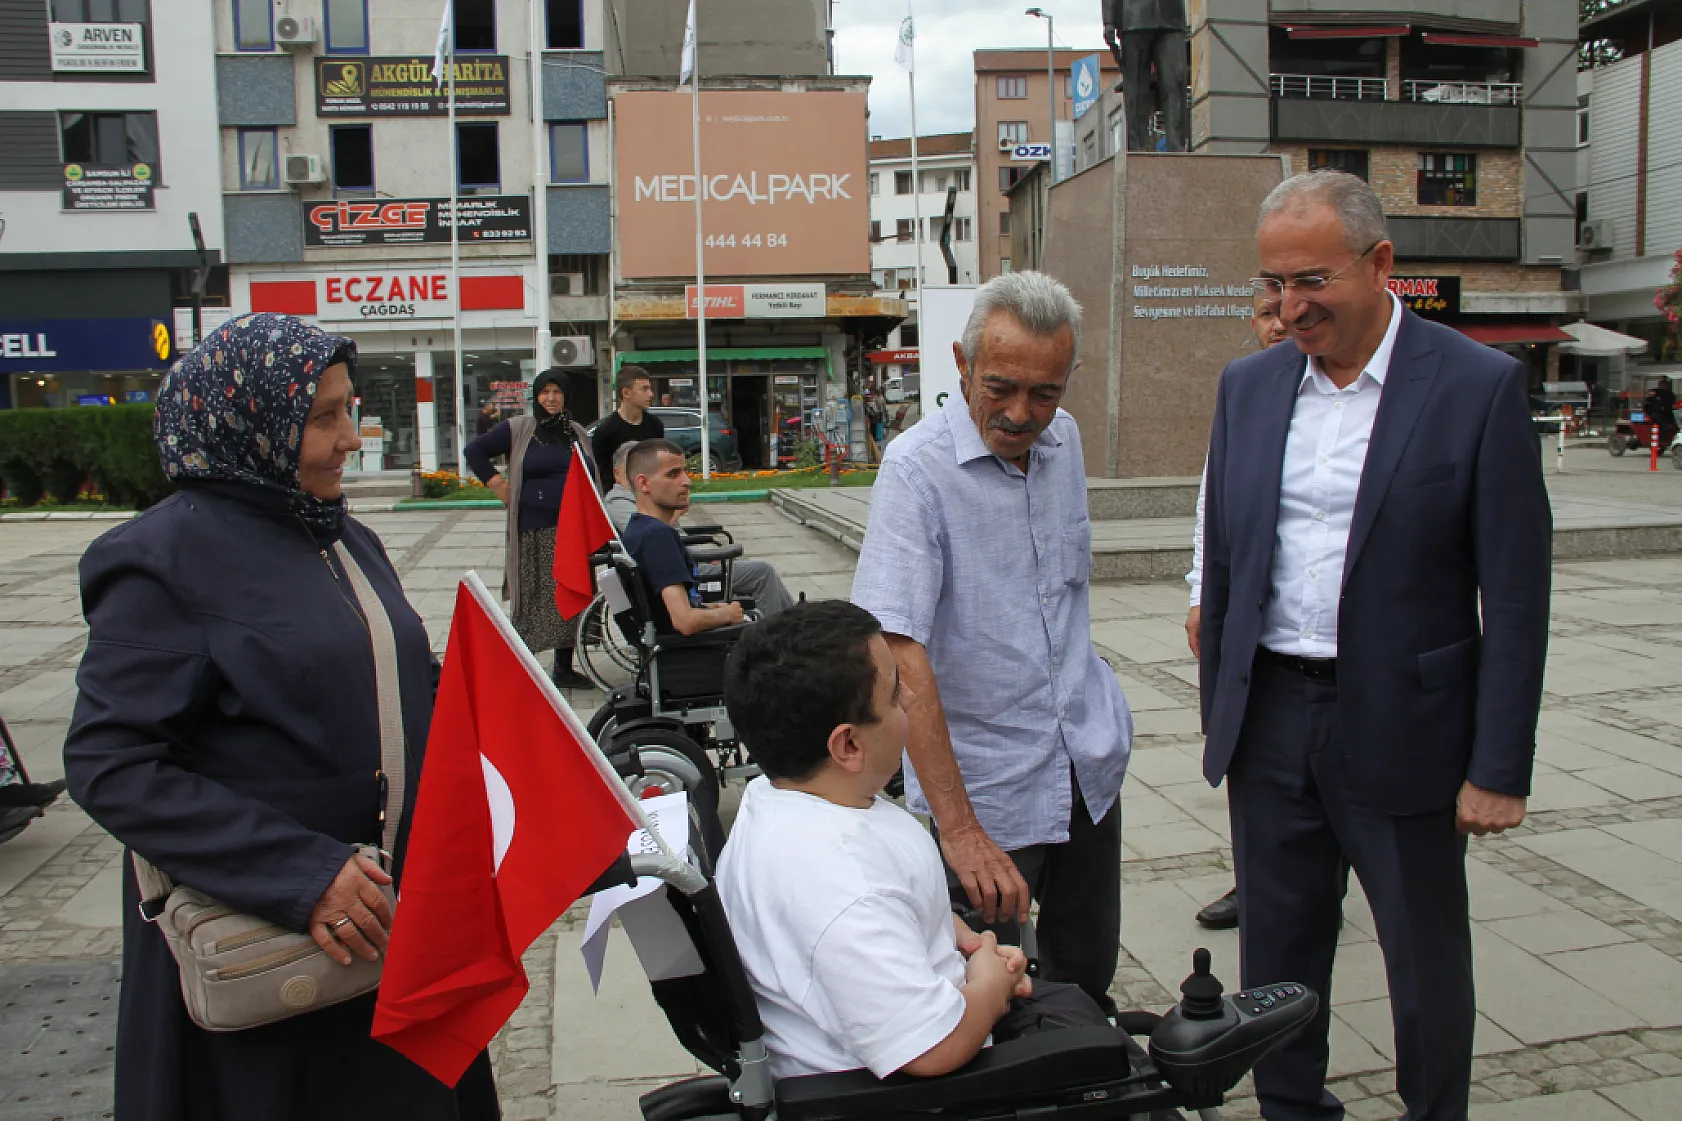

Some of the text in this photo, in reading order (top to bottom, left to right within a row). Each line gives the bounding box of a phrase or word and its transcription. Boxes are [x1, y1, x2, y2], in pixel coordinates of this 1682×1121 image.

[83, 28, 132, 42] ARVEN
[371, 59, 432, 82] AKGÜL
[443, 86, 505, 98] DNIŞMANLIK
[635, 170, 852, 204] MEDICALPARK
[310, 201, 431, 231] ÇİZGE
[437, 219, 483, 227] İNAAT
[705, 232, 788, 248] 444 44 84
[1132, 264, 1160, 279] Büyük
[326, 275, 448, 303] ECZANE
[1387, 279, 1438, 296] RMAK
[360, 303, 415, 319] ÇAĞDAŞ
[0, 333, 57, 358] ELL
